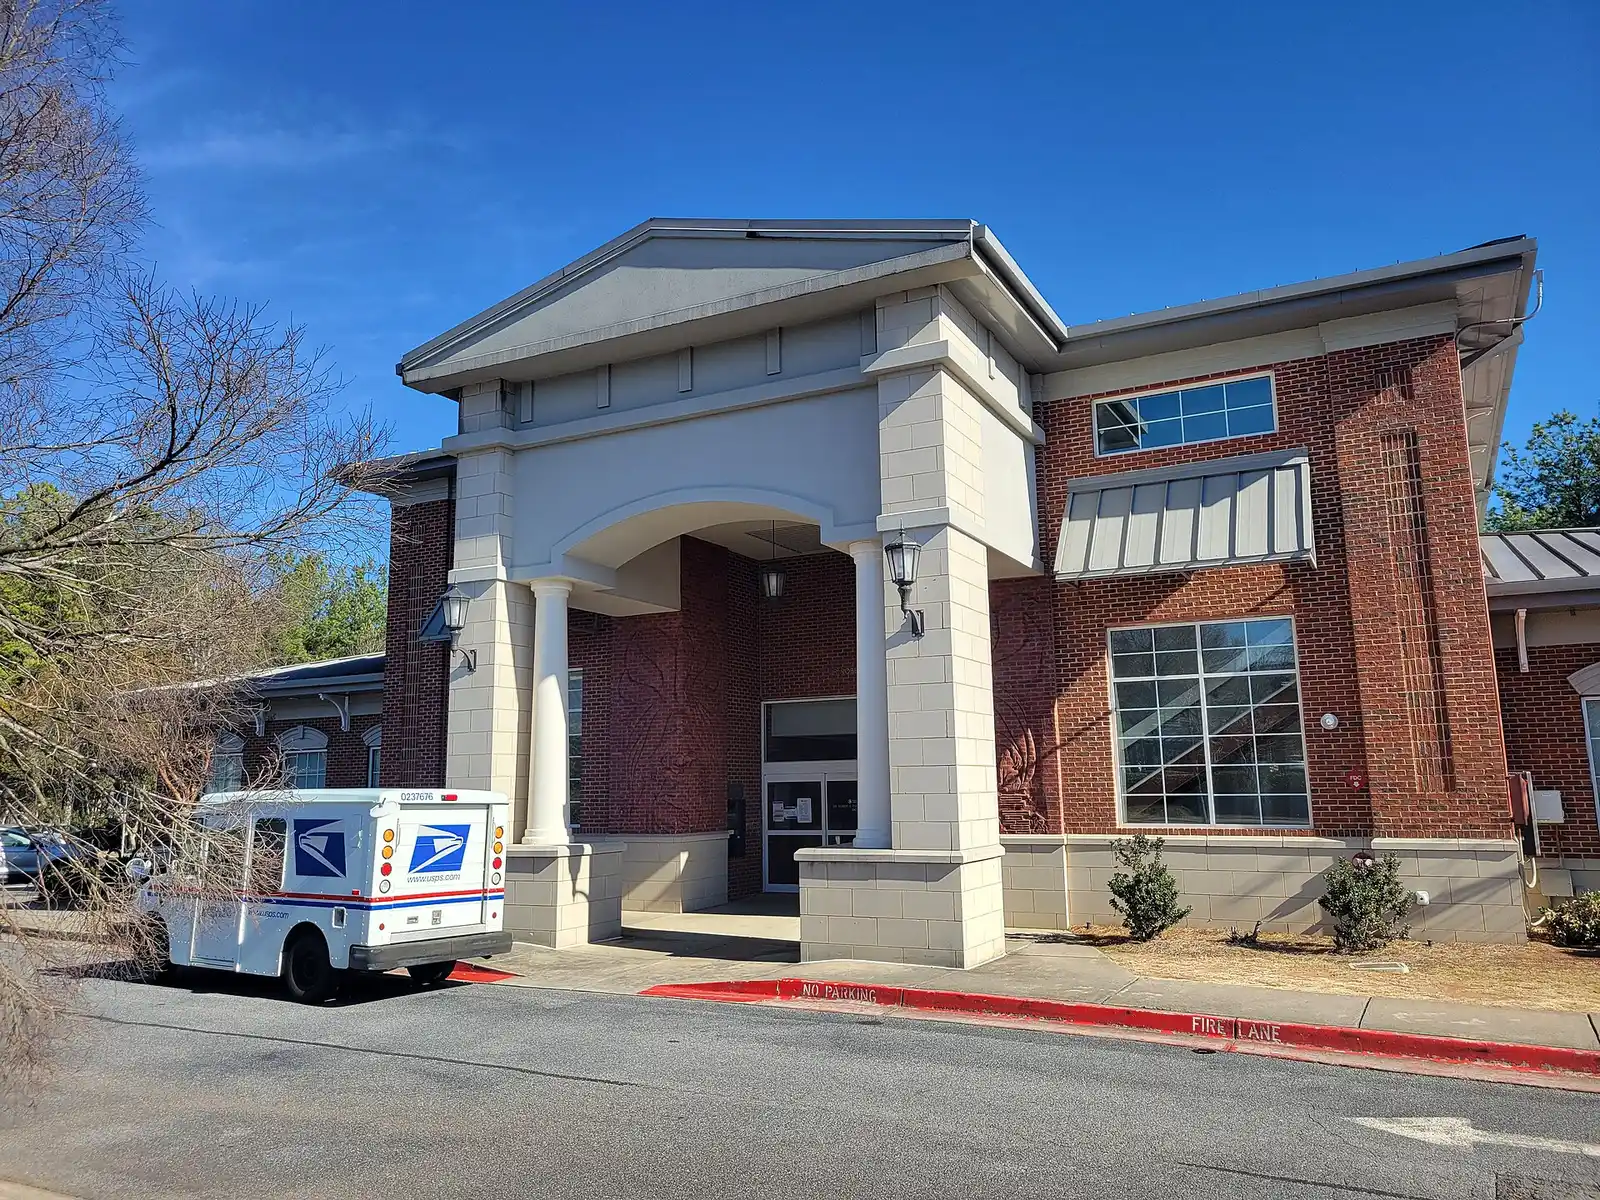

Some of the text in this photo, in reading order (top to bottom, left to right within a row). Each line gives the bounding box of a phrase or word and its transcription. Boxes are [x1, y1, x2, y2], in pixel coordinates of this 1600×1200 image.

[400, 792, 434, 801] 0237676
[407, 873, 461, 883] www.usps.com
[802, 983, 877, 1003] NO PARKING
[1192, 1016, 1281, 1042] FIRE LANE
